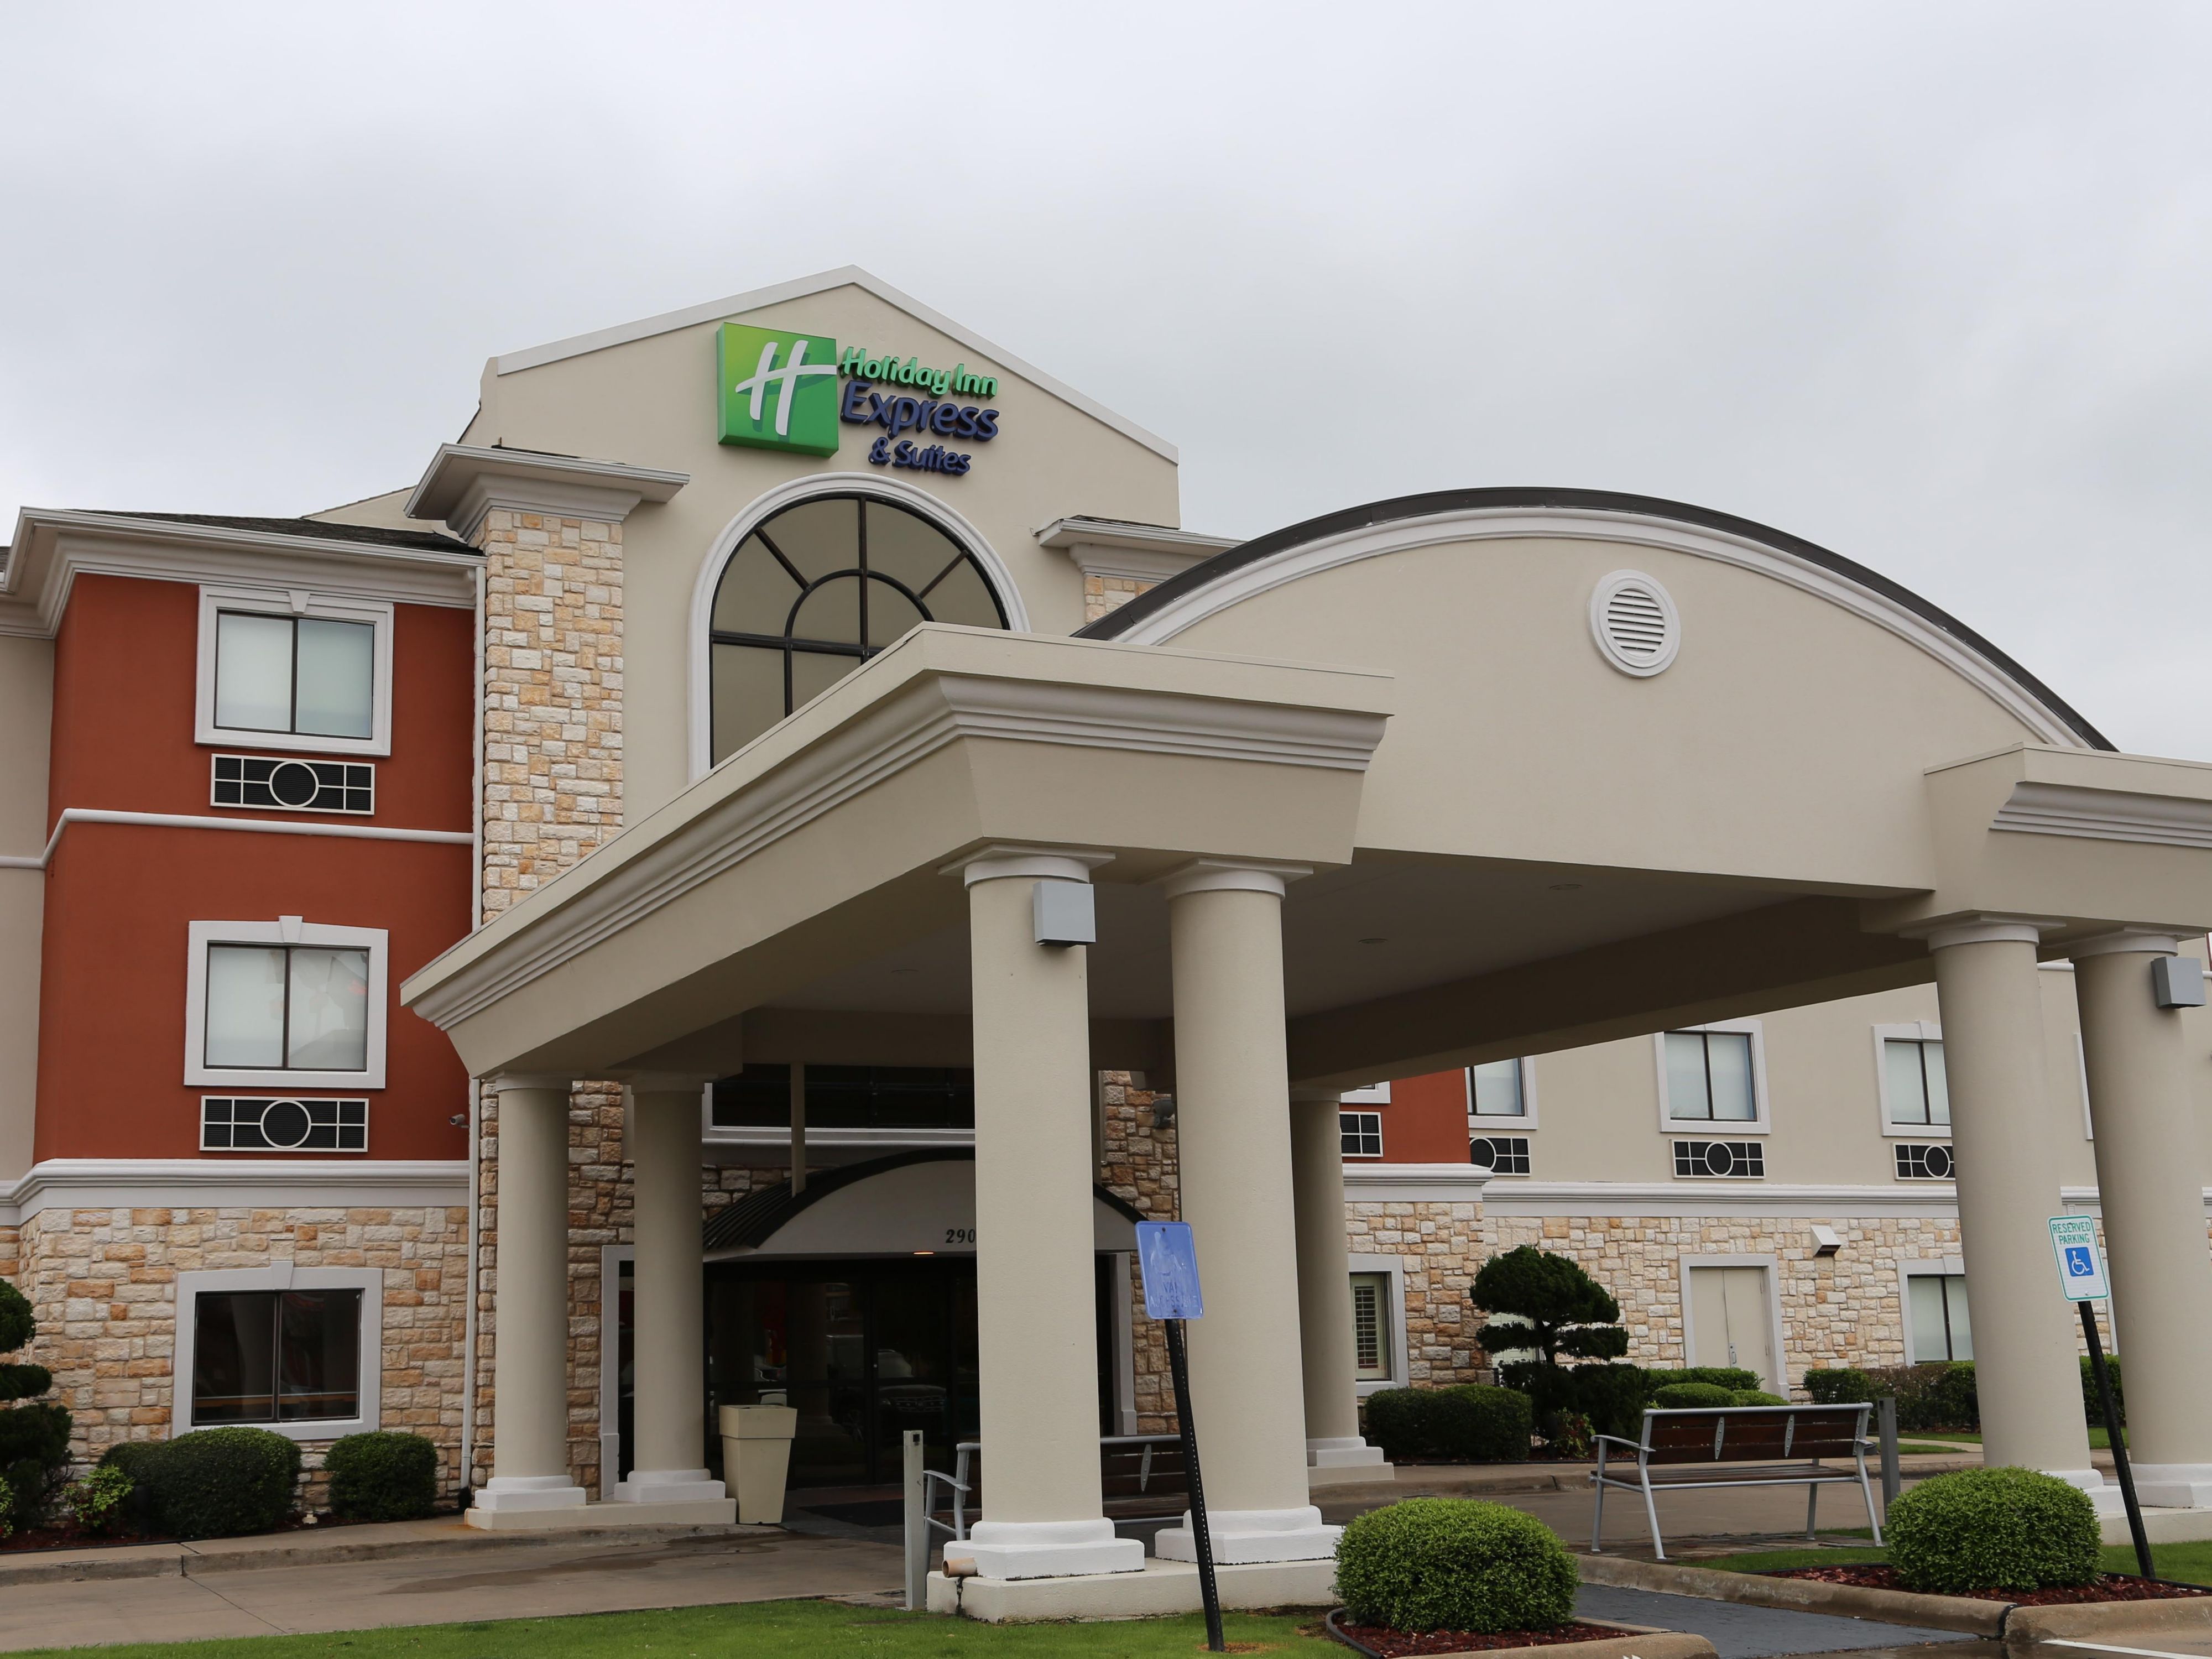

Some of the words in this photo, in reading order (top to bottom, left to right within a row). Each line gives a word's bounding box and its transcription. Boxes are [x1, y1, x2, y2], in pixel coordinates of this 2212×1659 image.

[838, 346, 951, 398] Holiday
[952, 363, 998, 399] Inn
[841, 380, 1000, 442] Express
[868, 437, 891, 465] &
[892, 440, 972, 476] Suites
[2052, 1222, 2091, 1234] RESERVED
[2058, 1233, 2090, 1244] PARKING
